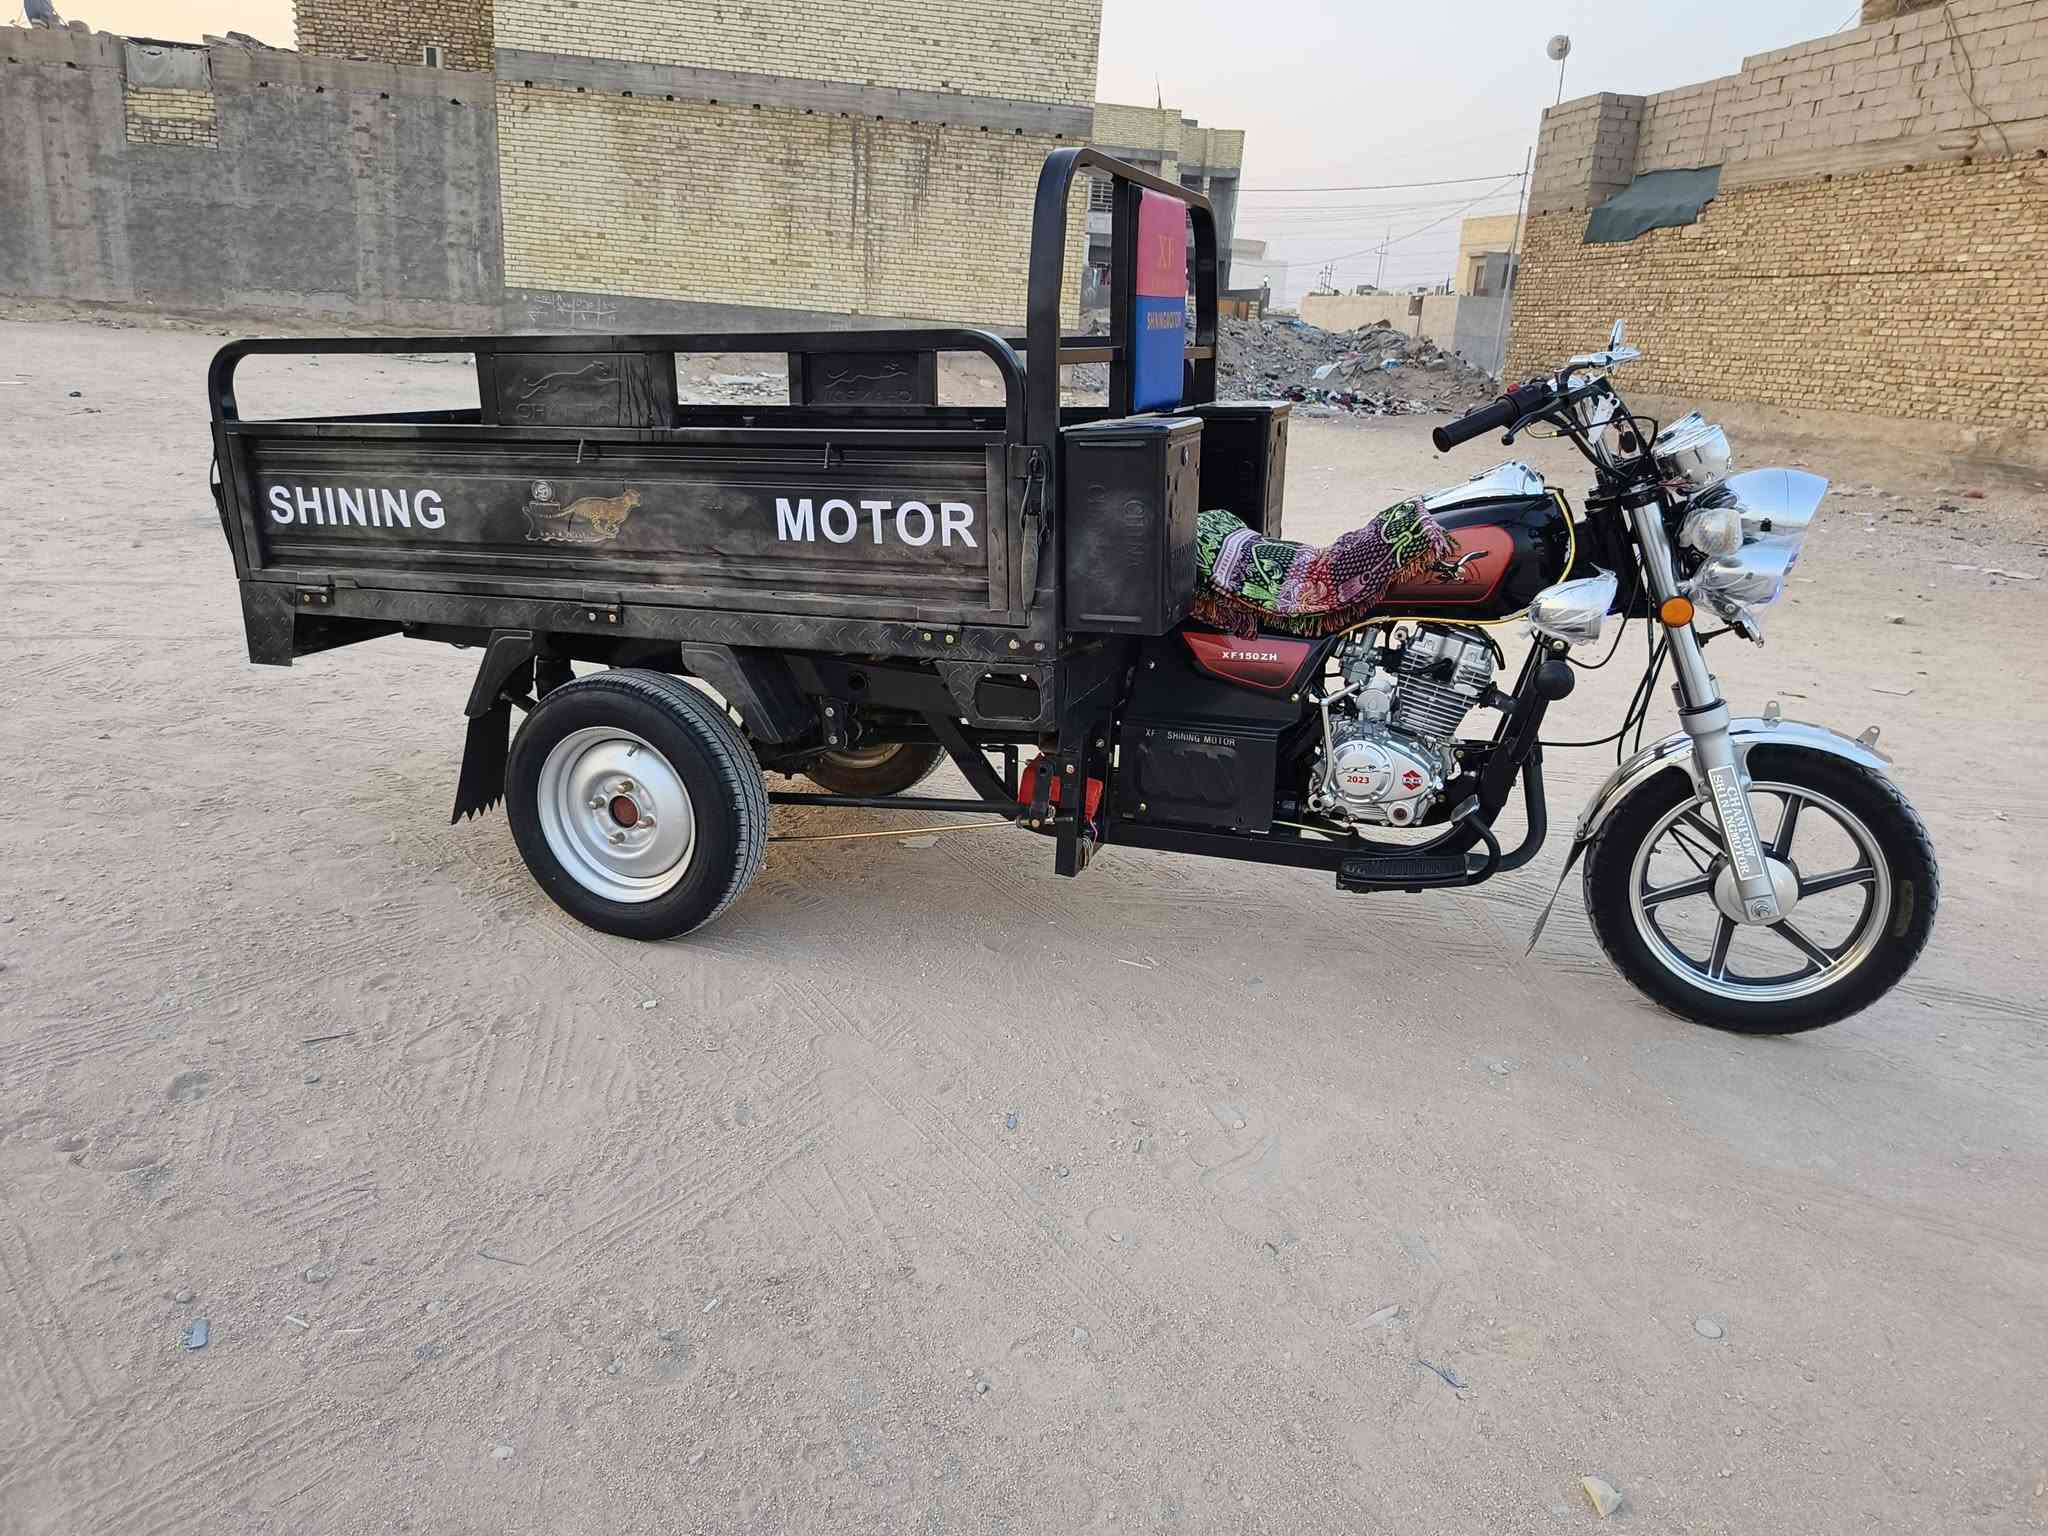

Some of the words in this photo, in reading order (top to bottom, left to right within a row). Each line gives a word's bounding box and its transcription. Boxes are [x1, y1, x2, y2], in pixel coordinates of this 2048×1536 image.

[267, 484, 448, 530] SHINING
[774, 496, 979, 548] MOTOR
[1221, 650, 1278, 662] XF150ZH
[1167, 730, 1201, 743] SHINING
[1203, 735, 1235, 746] MOTOR
[1346, 775, 1370, 784] 2023
